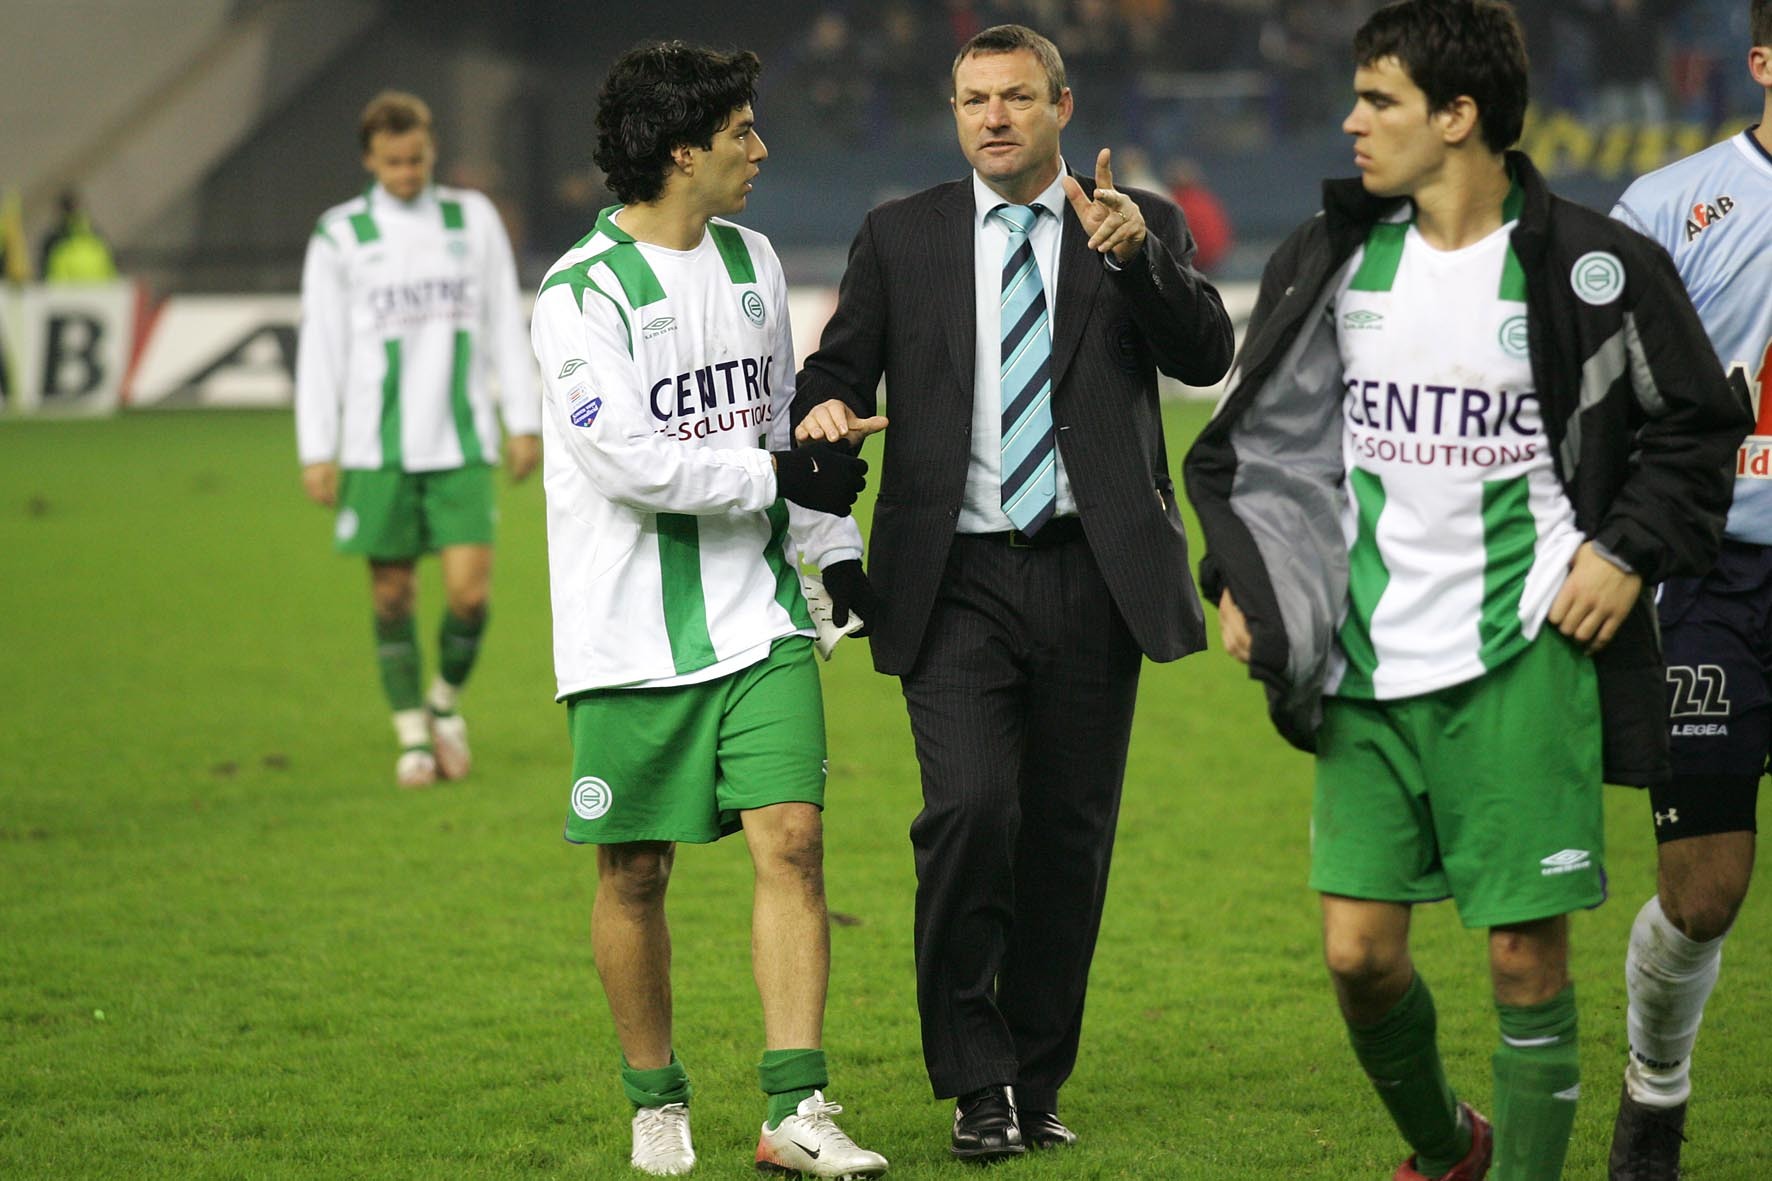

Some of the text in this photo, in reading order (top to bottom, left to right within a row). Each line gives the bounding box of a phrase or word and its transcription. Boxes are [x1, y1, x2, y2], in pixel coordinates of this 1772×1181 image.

[649, 355, 773, 422] CENTRIC
[1348, 378, 1539, 437] CENTRIC
[654, 403, 772, 441] -SOLUTIONS
[1351, 433, 1537, 467] -SOLUTIONS
[1665, 664, 1730, 718] 22
[1671, 723, 1728, 736] LEGEA
